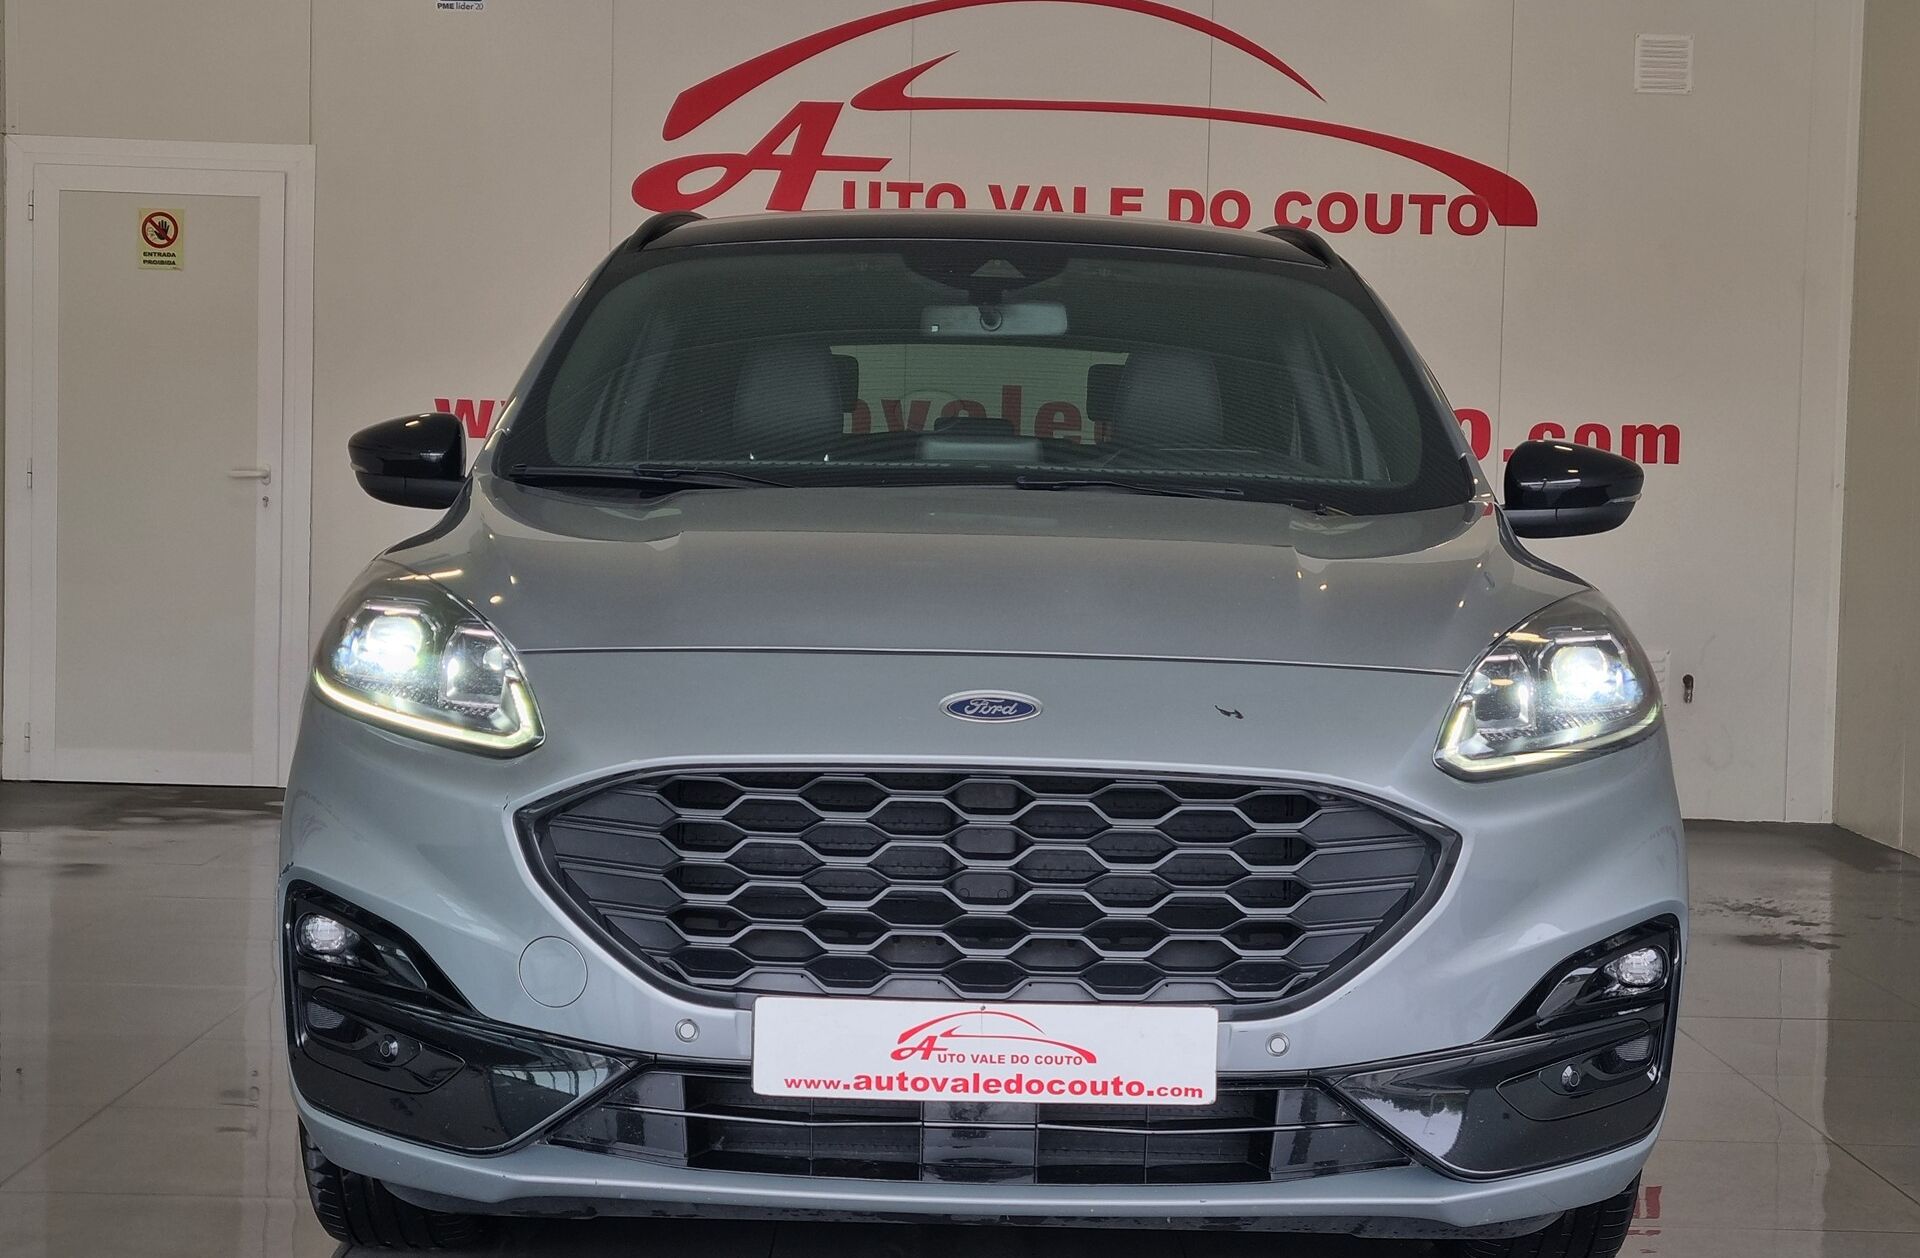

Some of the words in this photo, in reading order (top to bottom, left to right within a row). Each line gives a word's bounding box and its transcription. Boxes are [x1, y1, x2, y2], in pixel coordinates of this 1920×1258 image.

[632, 101, 967, 213] AUTO
[1168, 188, 1251, 229] DO
[1275, 191, 1489, 236] COUTO
[964, 698, 1018, 715] Ford
[890, 1035, 965, 1064] AUTO
[971, 1054, 1005, 1065] VALE
[1011, 1054, 1032, 1065] DO
[1034, 1055, 1083, 1066] COUTO
[784, 1070, 1204, 1099] www.autovaledocouto.com
